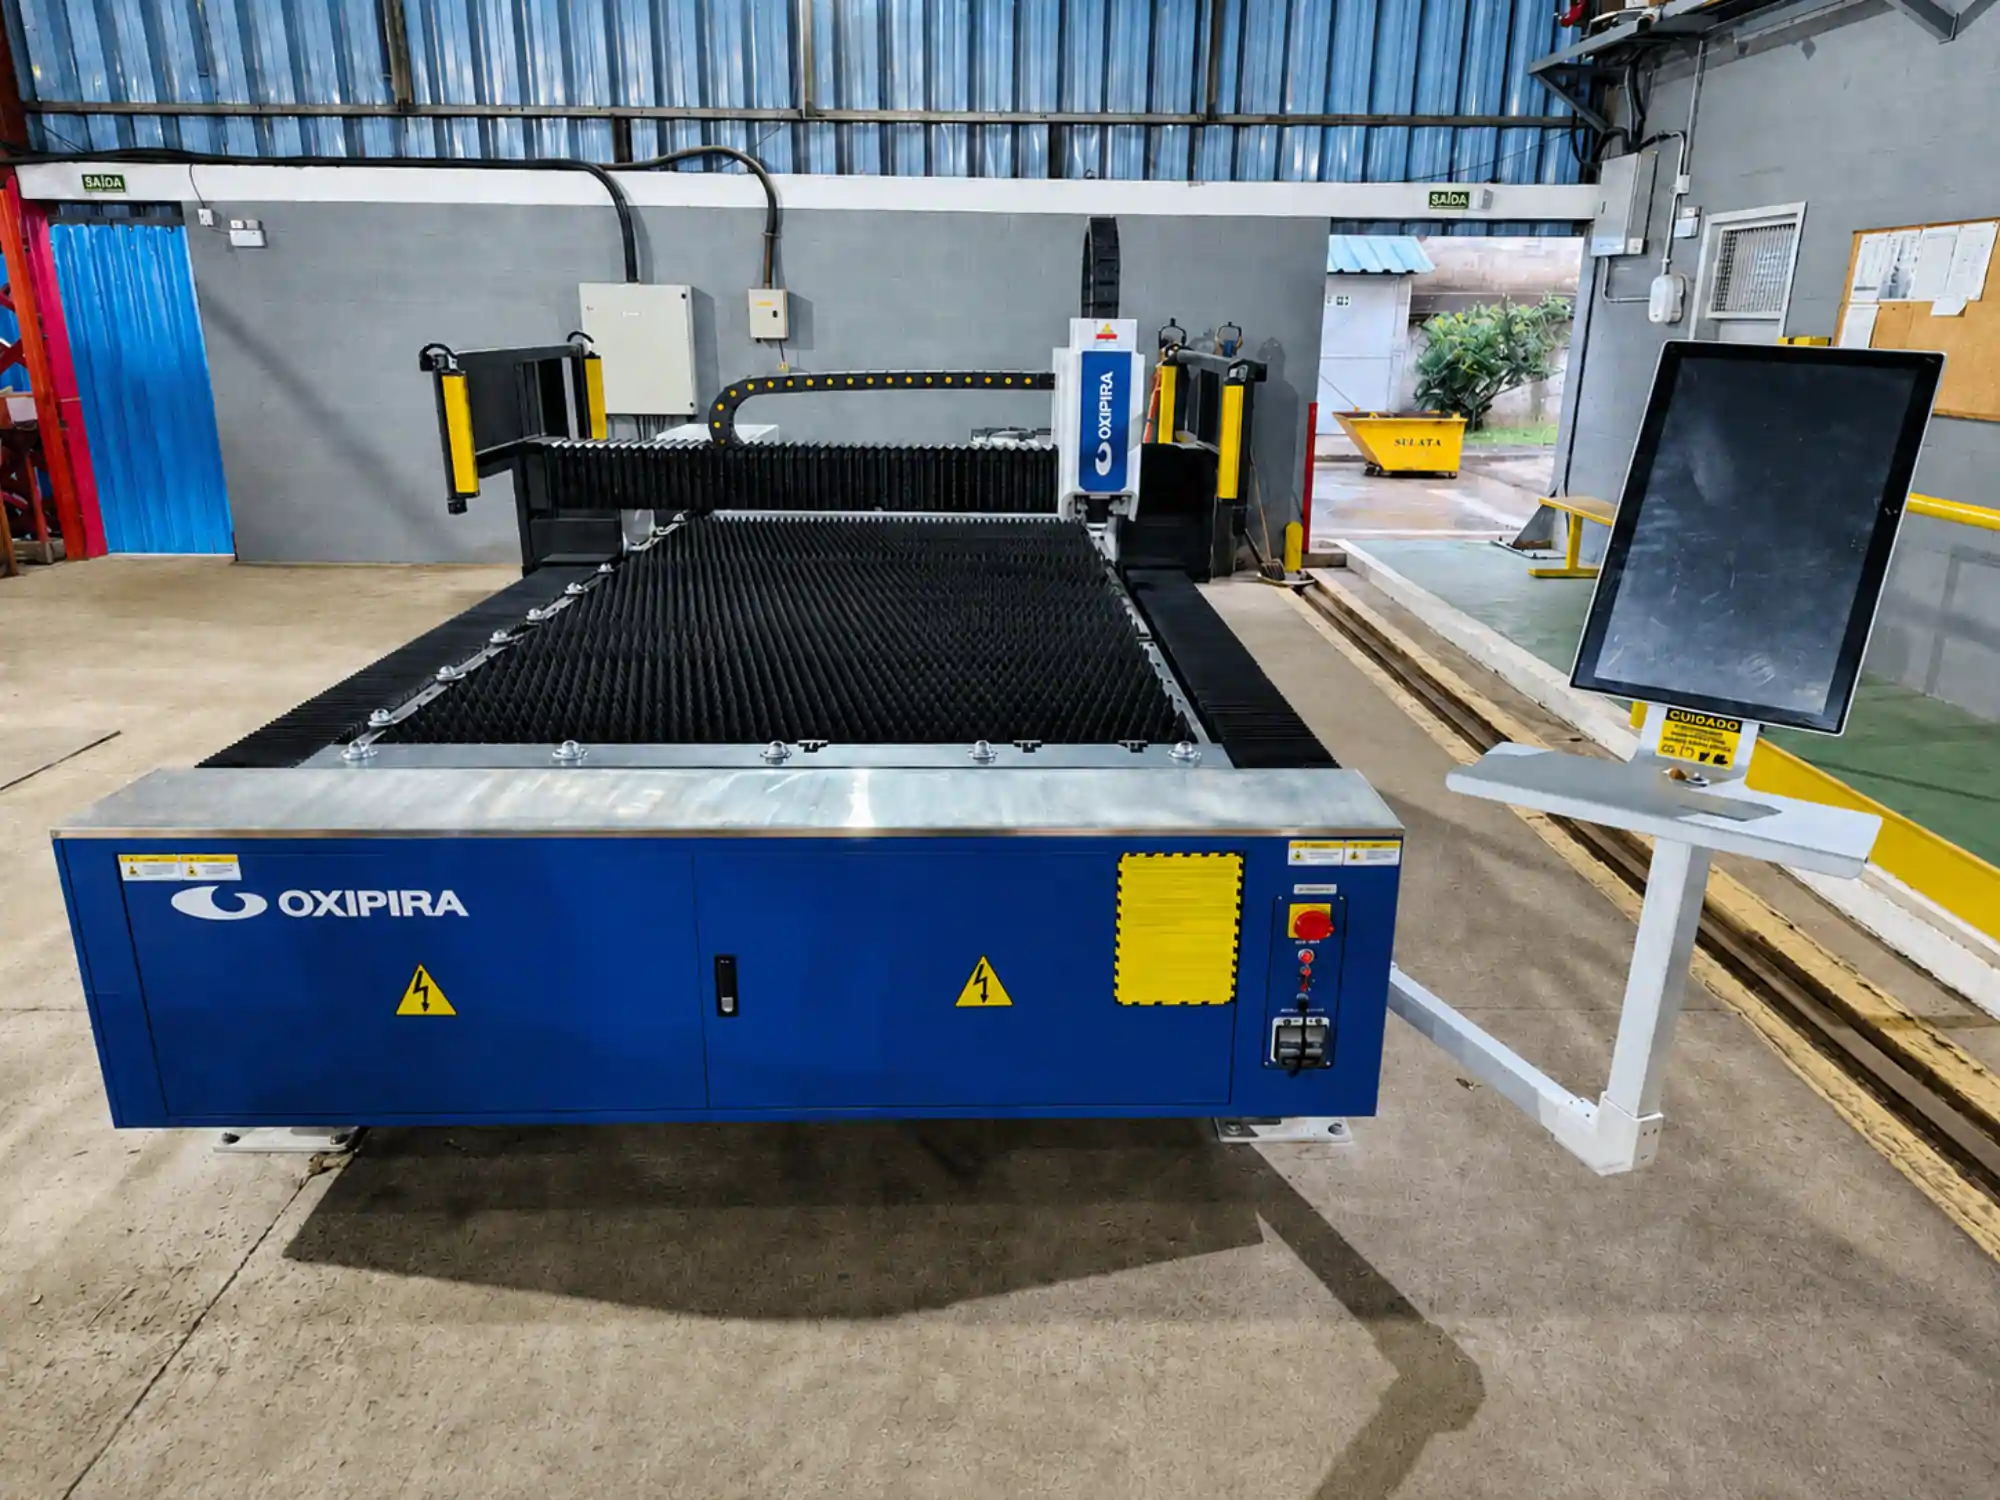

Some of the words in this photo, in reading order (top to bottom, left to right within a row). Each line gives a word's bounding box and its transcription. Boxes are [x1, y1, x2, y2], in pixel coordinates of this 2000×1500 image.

[85, 174, 123, 188] SAÍDA
[1431, 191, 1468, 205] SAÍDA
[1098, 371, 1114, 440] OXIPIRA
[1669, 710, 1739, 731] CUIDADO
[278, 889, 470, 918] OXIPIRA
